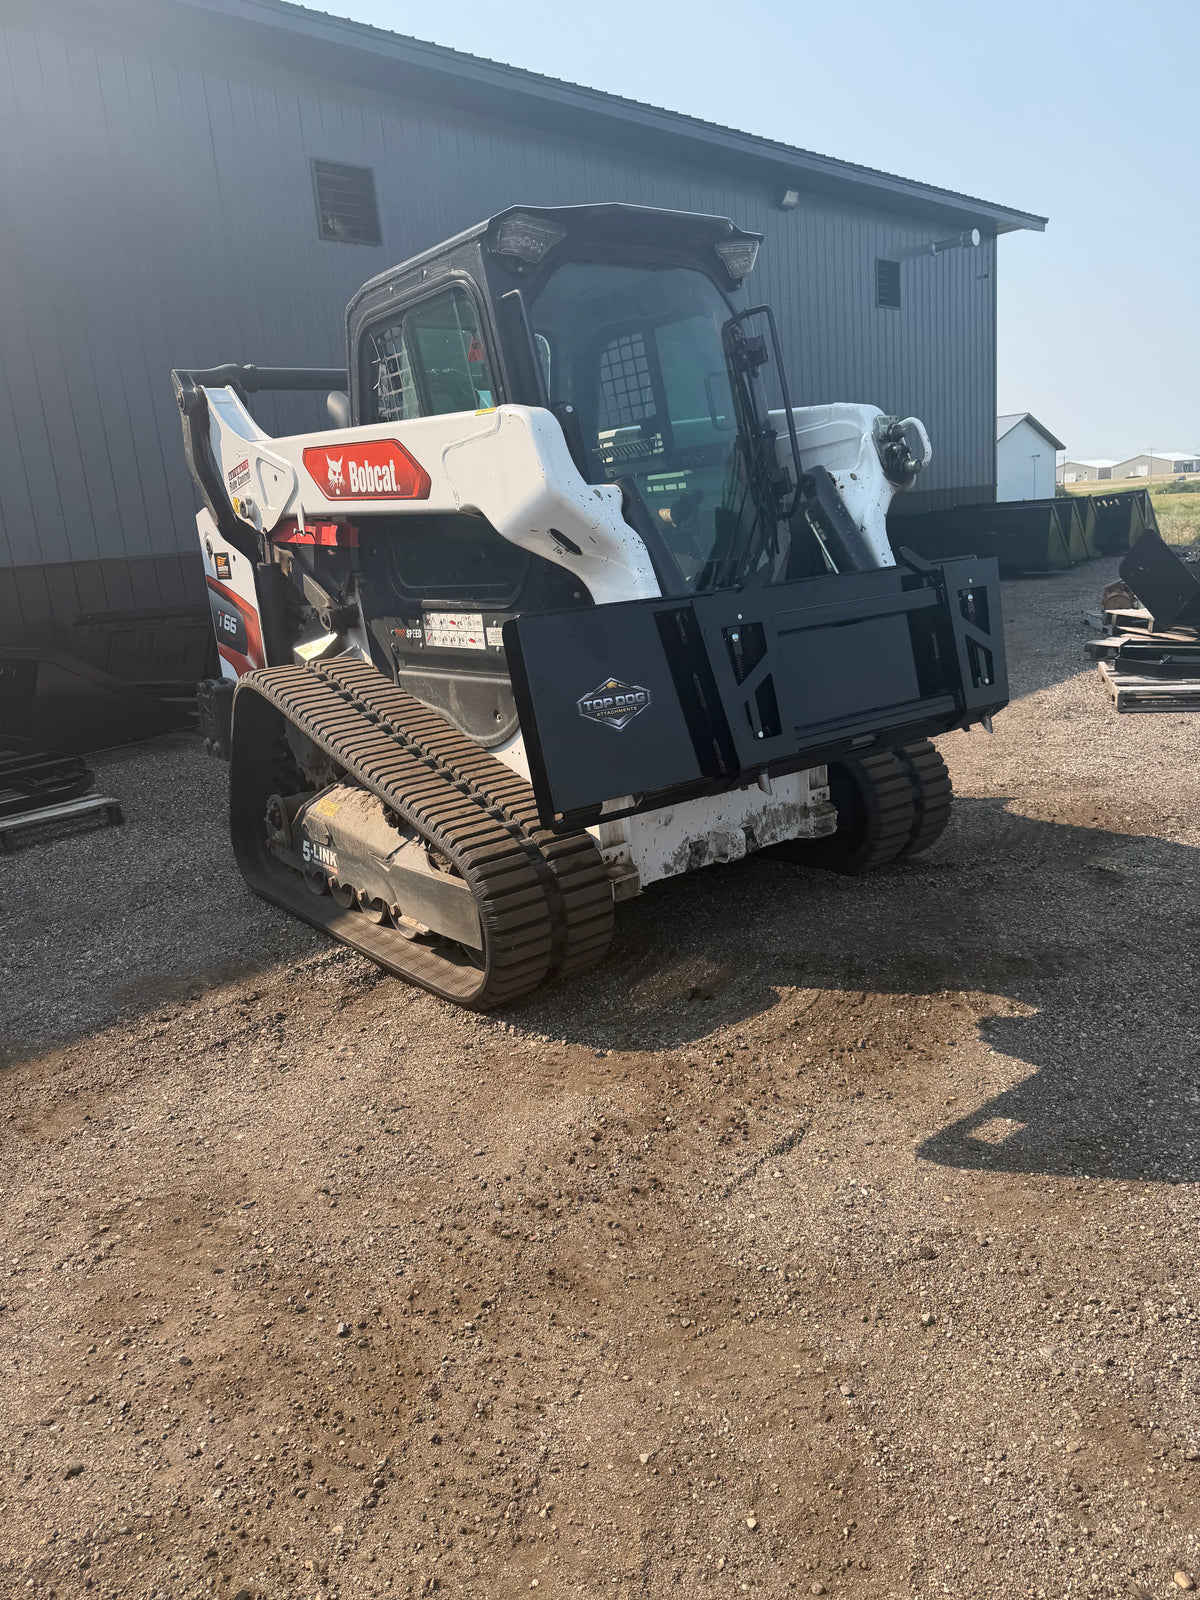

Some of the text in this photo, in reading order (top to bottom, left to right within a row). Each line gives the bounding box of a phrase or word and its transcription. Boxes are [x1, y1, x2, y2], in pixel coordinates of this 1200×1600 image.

[348, 460, 397, 493] Bobcat
[406, 629, 422, 638] SPEED
[583, 692, 646, 711] TOP DOG
[596, 706, 638, 717] ATTACHMENTS
